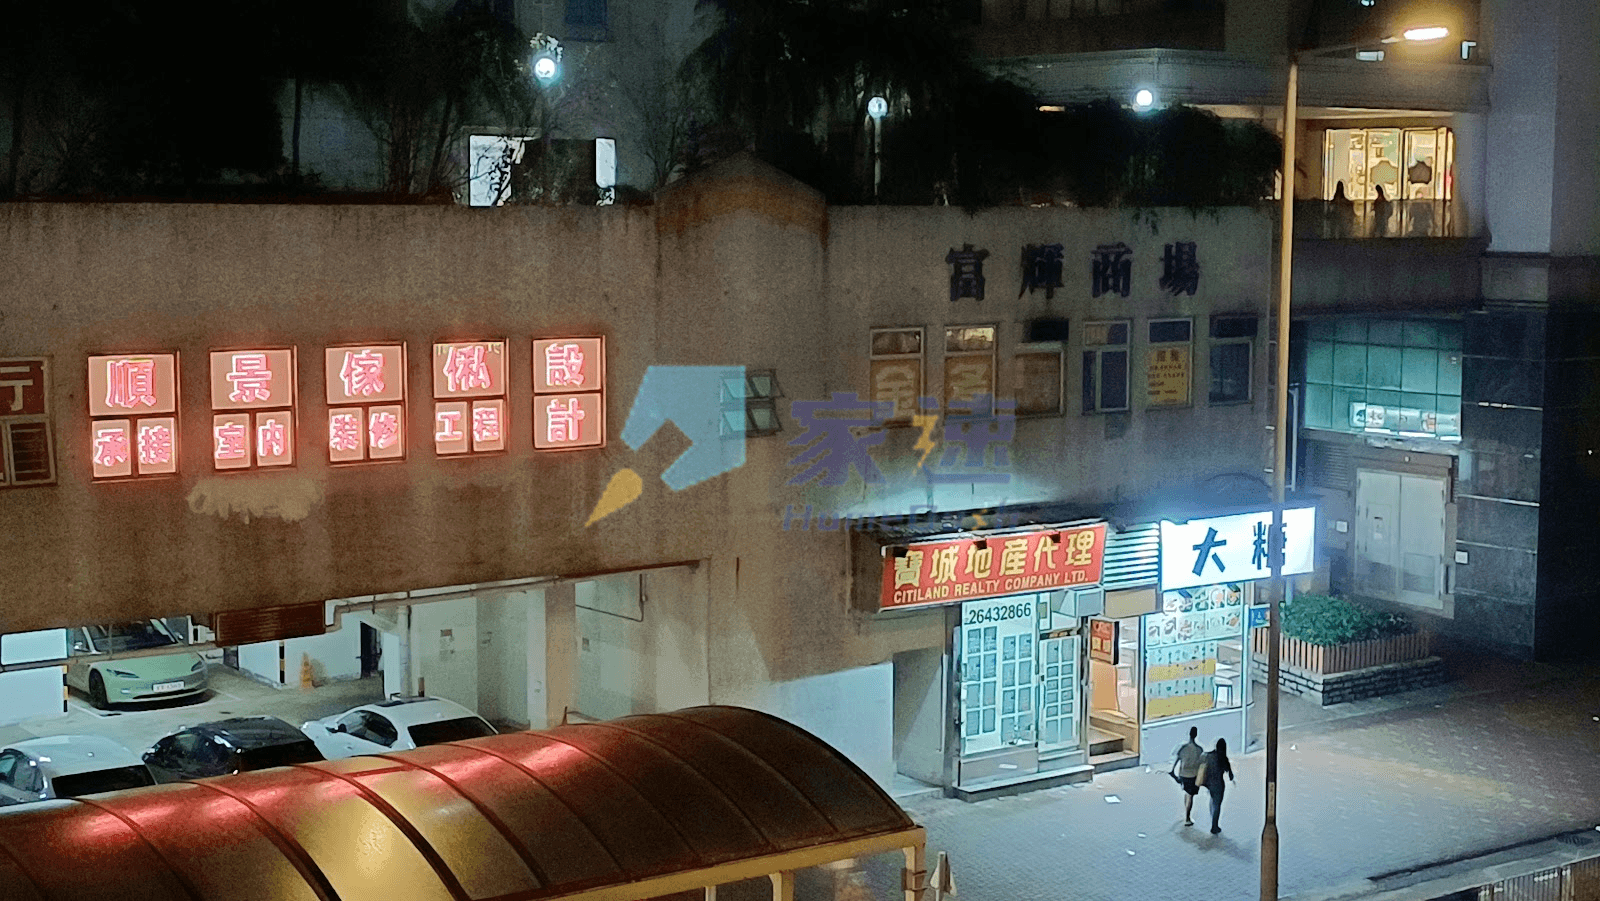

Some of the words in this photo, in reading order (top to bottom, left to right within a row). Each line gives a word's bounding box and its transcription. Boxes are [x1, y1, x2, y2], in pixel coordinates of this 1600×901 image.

[893, 585, 949, 604] CITILAND
[954, 580, 1000, 597] REALTY
[1005, 574, 1060, 591] COMPANY
[1064, 570, 1089, 583] LTD.
[969, 602, 1031, 624] 26432866
